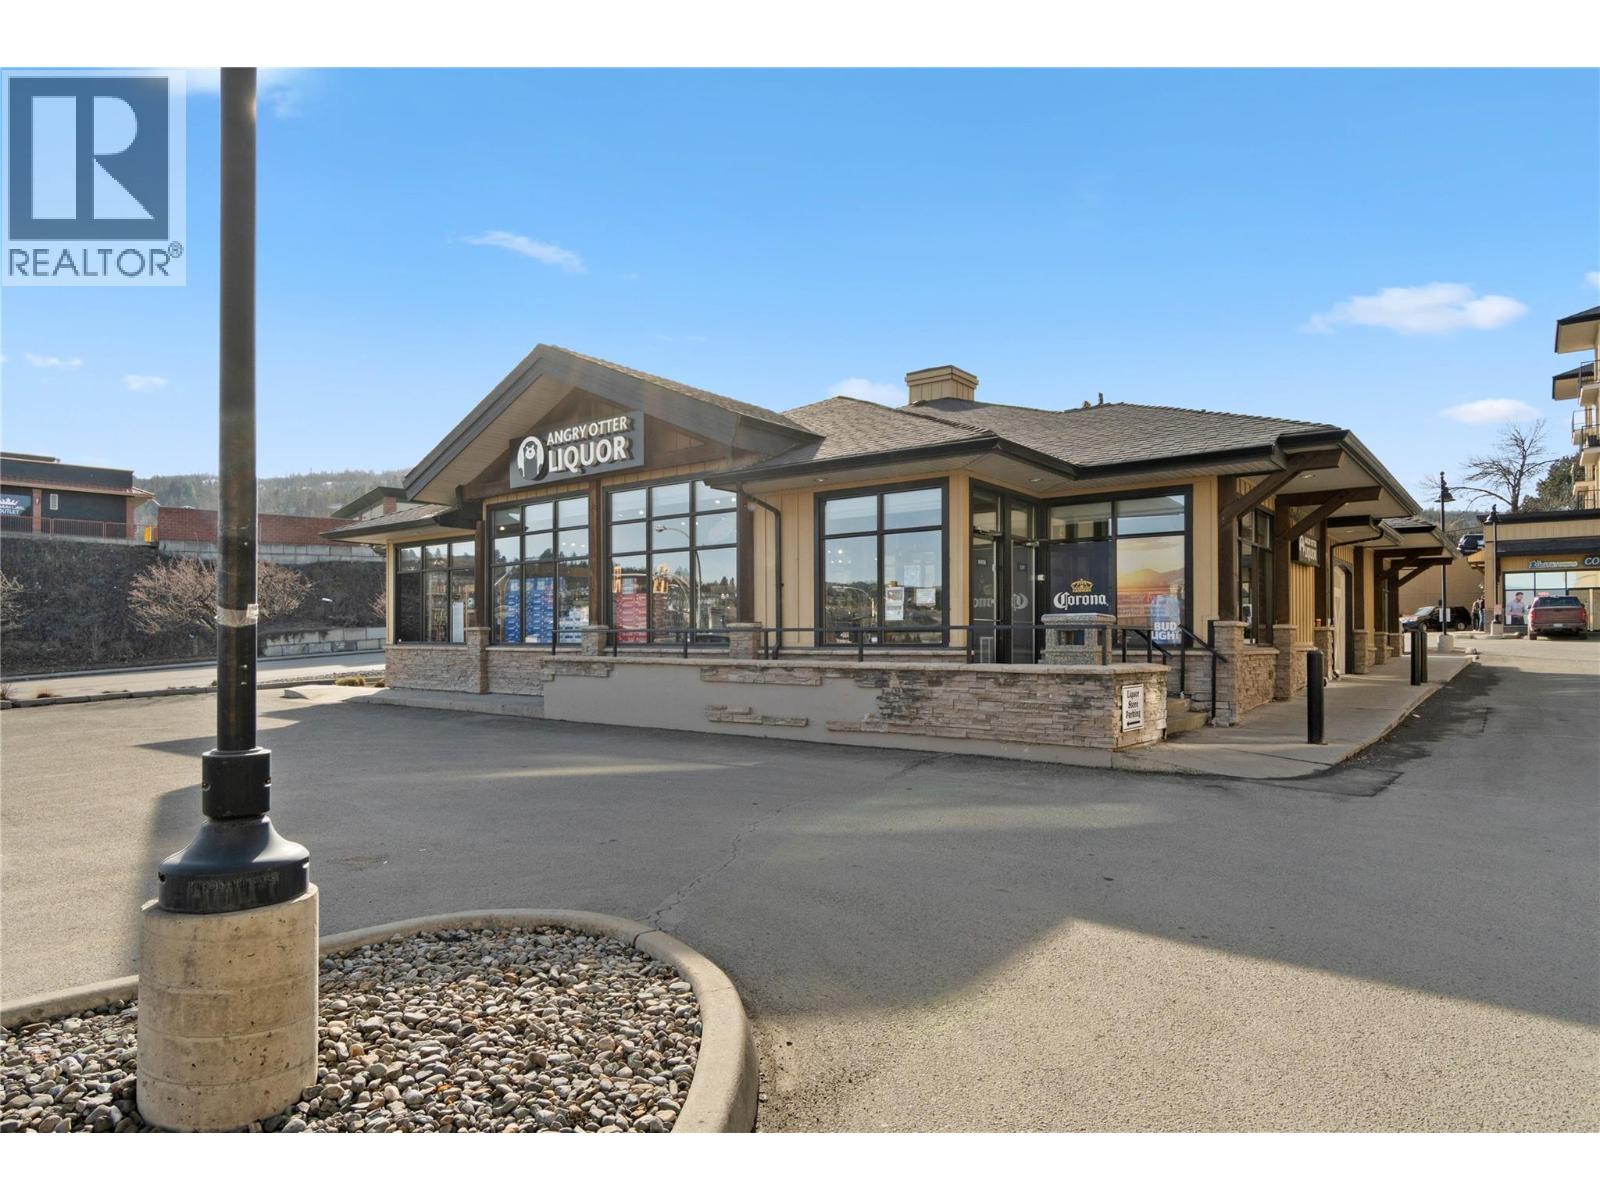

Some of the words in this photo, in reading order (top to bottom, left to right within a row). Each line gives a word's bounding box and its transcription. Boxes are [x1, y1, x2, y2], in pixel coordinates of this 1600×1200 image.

[546, 424, 588, 446] ANGRY
[588, 415, 630, 437] OTTER
[548, 435, 629, 474] LIQUOR
[1053, 591, 1109, 611] Corona
[1153, 621, 1178, 631] BUD
